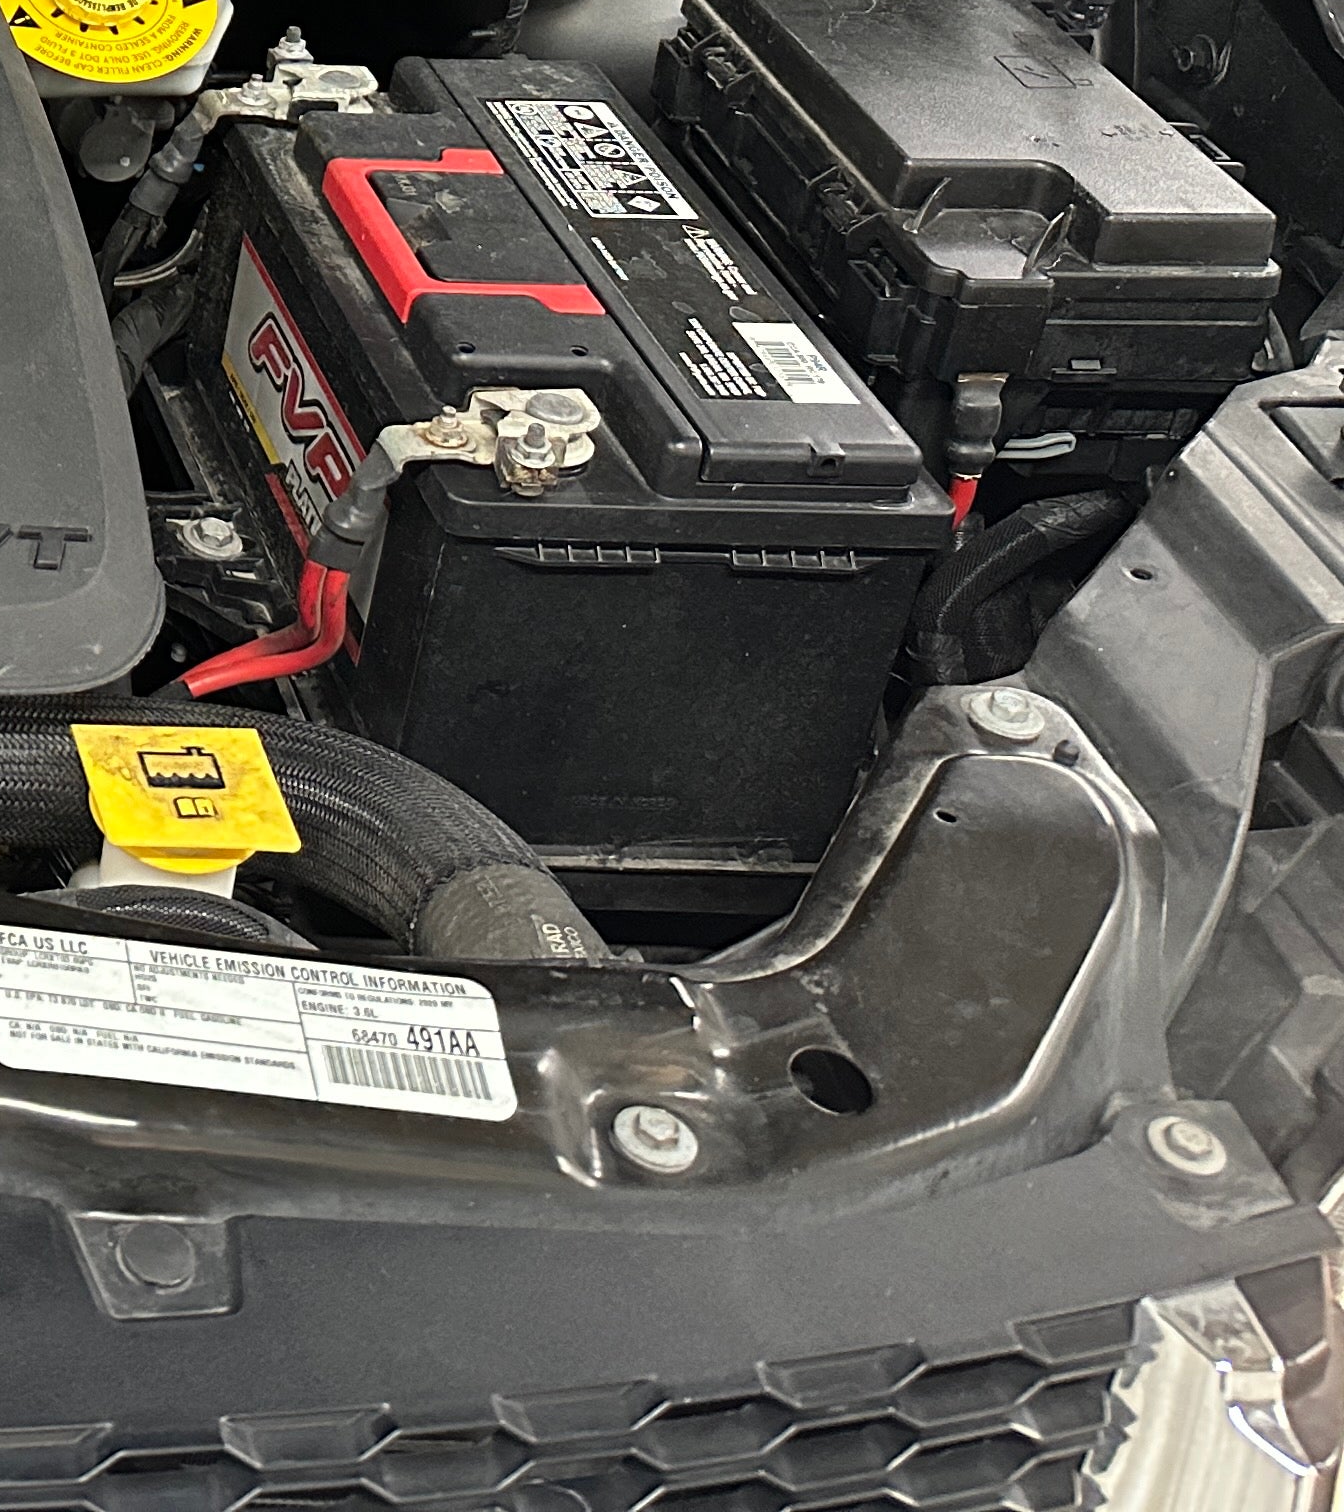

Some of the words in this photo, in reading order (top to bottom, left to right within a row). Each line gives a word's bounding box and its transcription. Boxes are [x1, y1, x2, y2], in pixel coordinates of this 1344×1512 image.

[115, 36, 151, 51] SEALED
[34, 44, 72, 67] BEFORE
[79, 53, 102, 63] DOT
[103, 56, 130, 65] ONLY
[133, 50, 151, 61] USE
[73, 62, 94, 73] CAP
[96, 67, 130, 76] FILLER
[132, 59, 163, 74] CLEAN
[248, 311, 355, 503] FVP
[32, 936, 55, 951] US
[60, 939, 88, 956] LLC
[149, 949, 212, 970] VEHICLE
[216, 957, 286, 978] EMISSION
[291, 967, 359, 987] CONTROL
[362, 975, 467, 996] INFORMATION
[352, 1027, 398, 1048] 68470
[406, 1024, 481, 1058] 491AA
